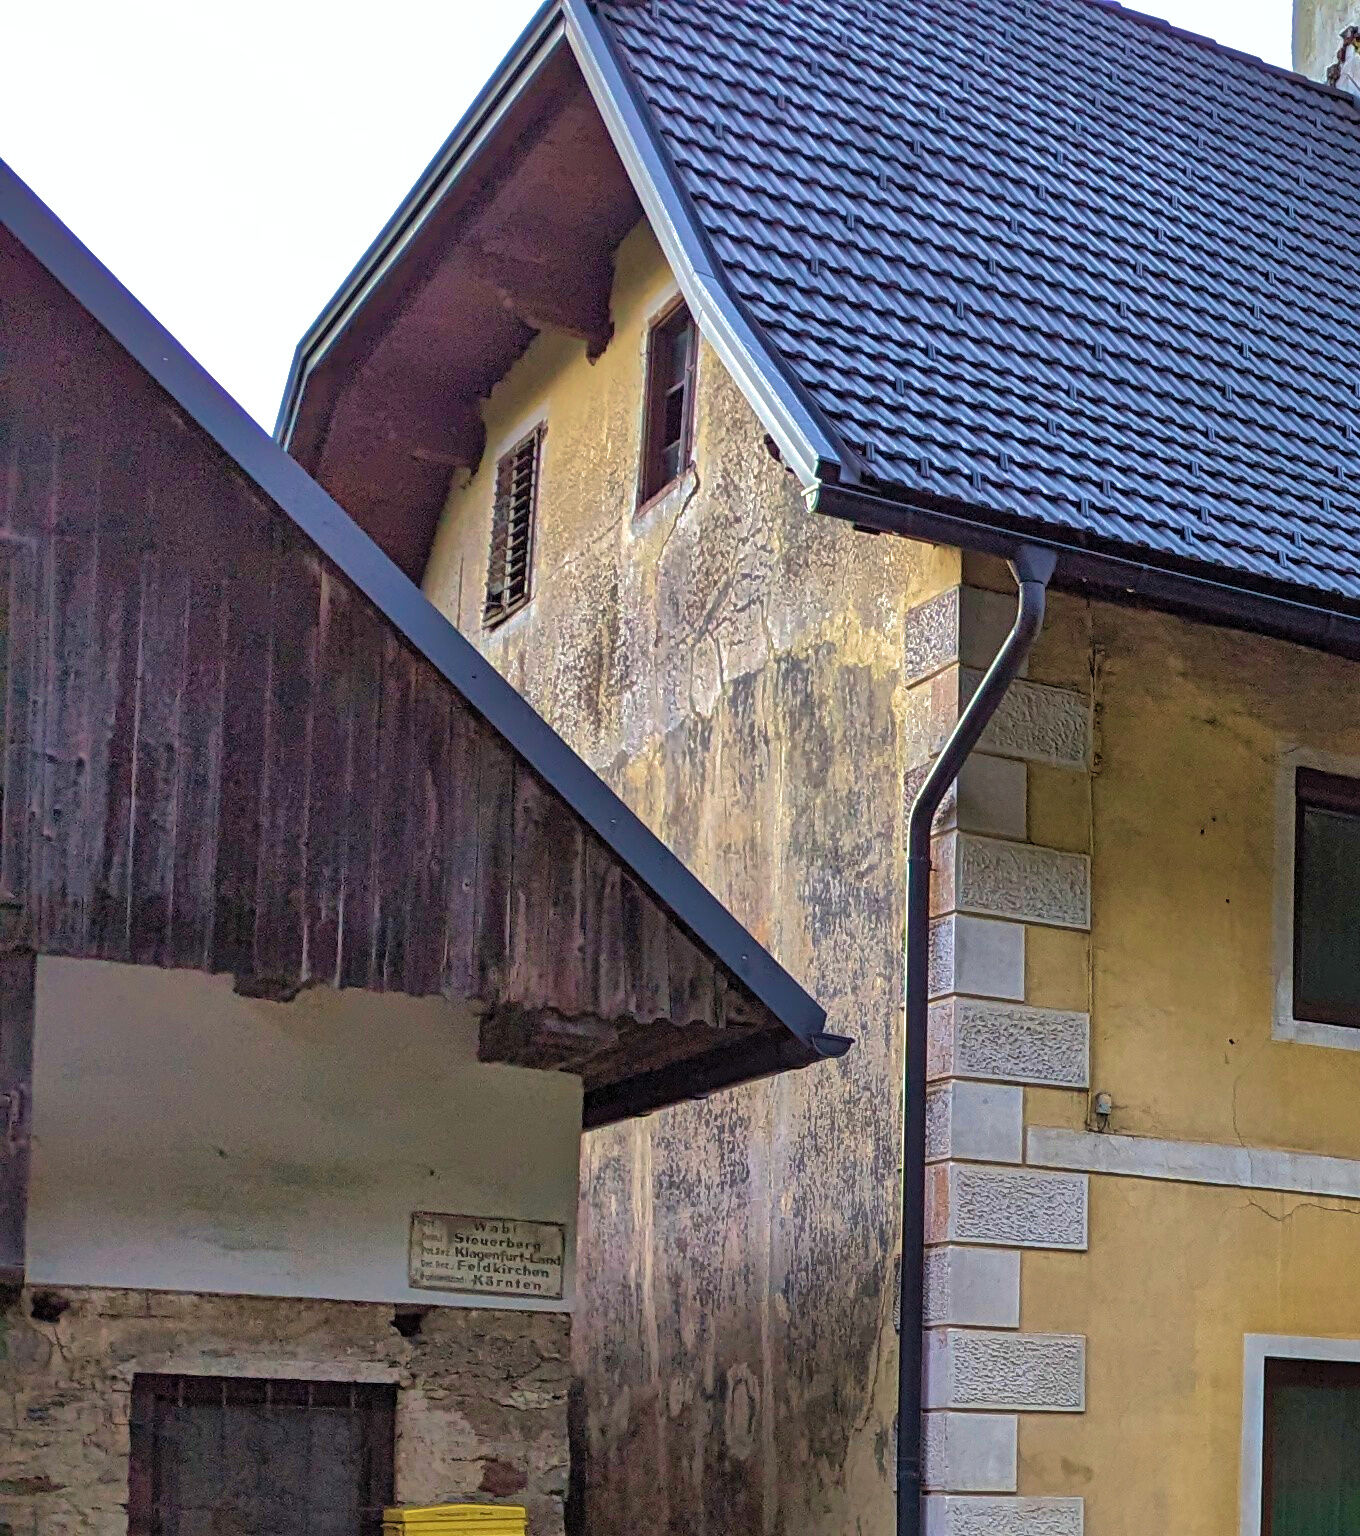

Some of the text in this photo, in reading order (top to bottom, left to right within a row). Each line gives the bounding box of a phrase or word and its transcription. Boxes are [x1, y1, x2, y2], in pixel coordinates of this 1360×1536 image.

[454, 1246, 561, 1266] Klagenfurt-Land
[457, 1260, 549, 1278] Feldkirchen
[471, 1274, 541, 1291] Kärnten
